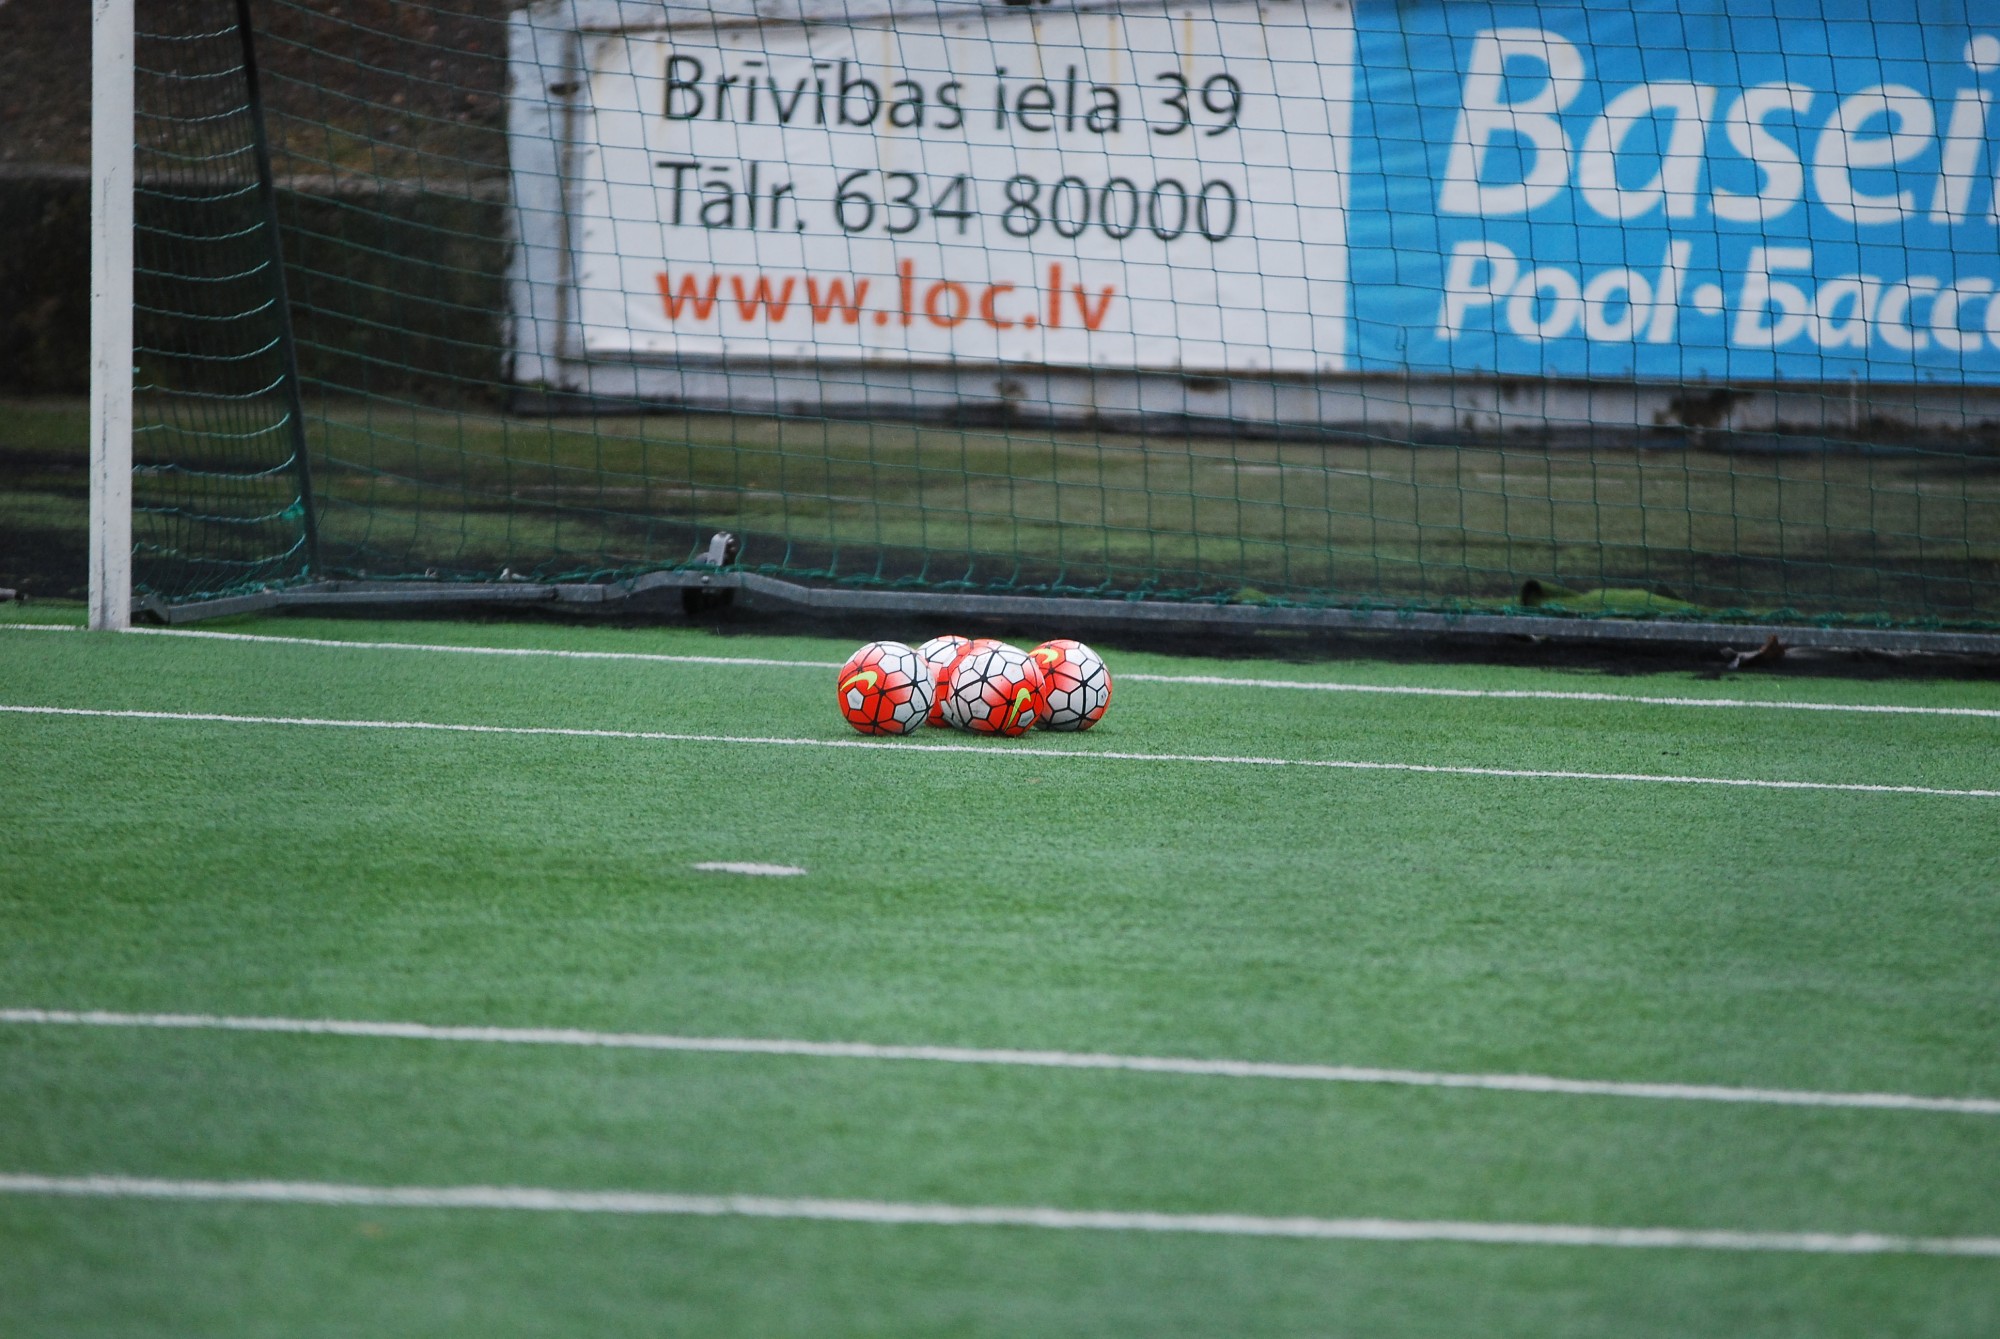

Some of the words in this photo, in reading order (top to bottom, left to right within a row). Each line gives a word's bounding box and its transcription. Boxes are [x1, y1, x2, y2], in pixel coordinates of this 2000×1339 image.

[663, 53, 964, 130] Brīvības
[995, 65, 1121, 134] iela
[1152, 72, 1242, 137] 39
[1438, 27, 2000, 225] Basei
[656, 160, 806, 232] Tālr.
[834, 170, 974, 235] 634
[1002, 174, 1238, 242] 80000
[655, 259, 1115, 331] www.loc.lv
